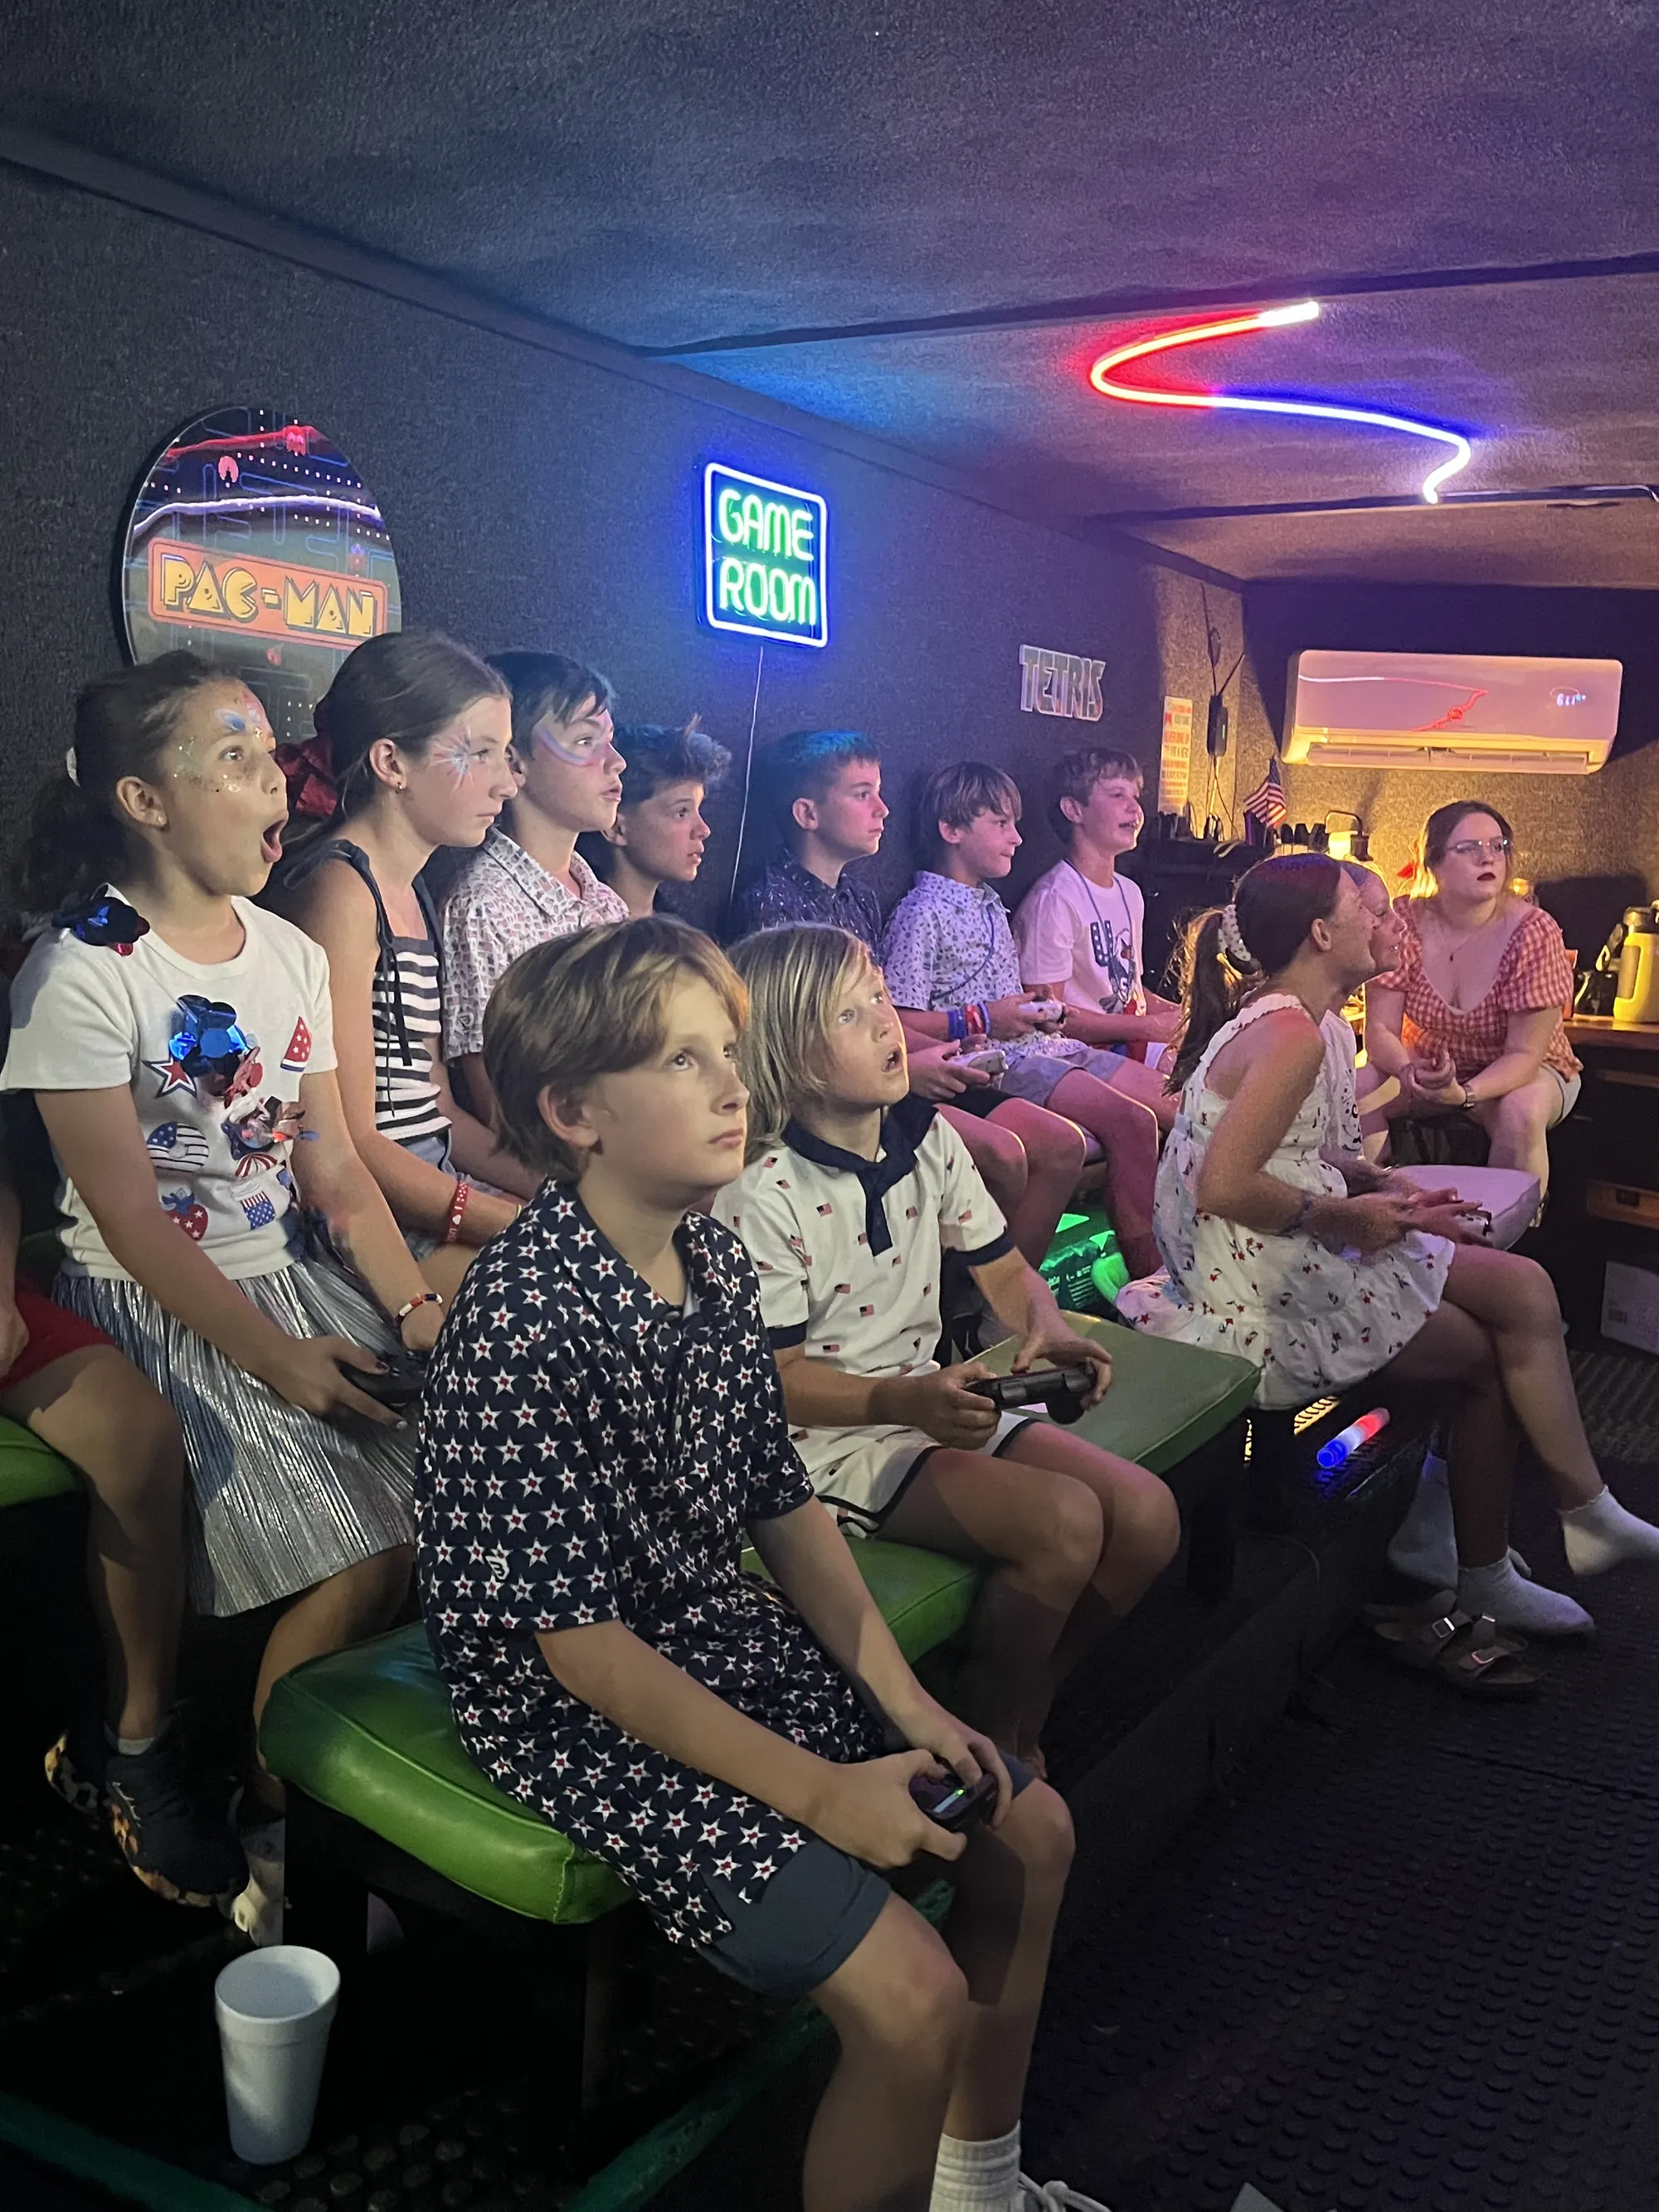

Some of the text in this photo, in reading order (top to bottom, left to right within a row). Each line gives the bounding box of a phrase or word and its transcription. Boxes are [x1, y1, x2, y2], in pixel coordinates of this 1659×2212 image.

[718, 489, 815, 562] GAME
[161, 553, 378, 639] PAC-MAN
[719, 557, 816, 626] ROOM
[1019, 644, 1106, 722] TETRIS
